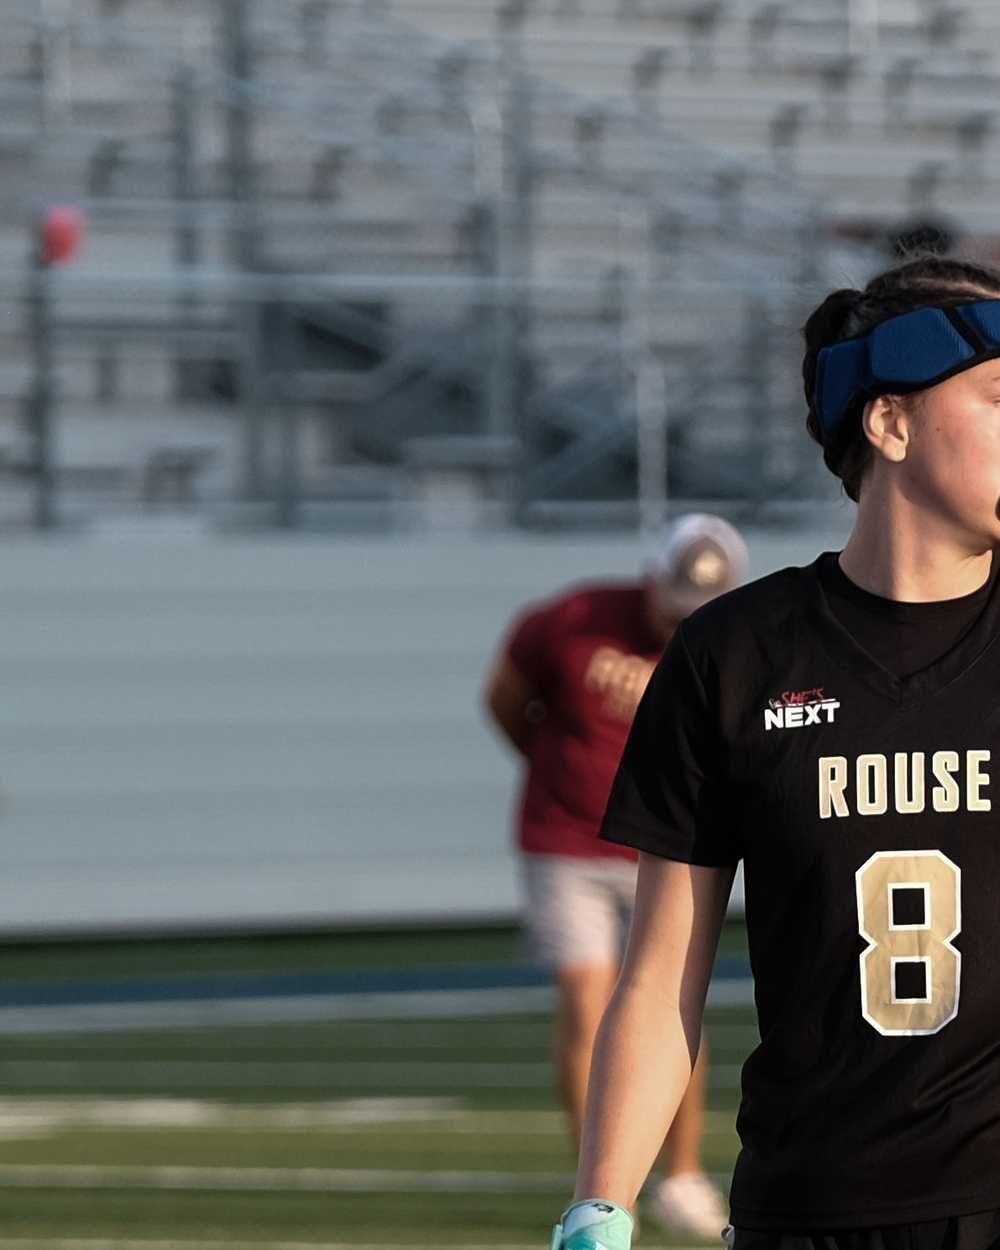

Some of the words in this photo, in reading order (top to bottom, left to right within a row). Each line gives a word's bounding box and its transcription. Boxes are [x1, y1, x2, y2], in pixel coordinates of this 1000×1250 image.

[764, 702, 840, 731] NEXT
[818, 750, 992, 818] ROUSE
[855, 850, 962, 1037] 8
